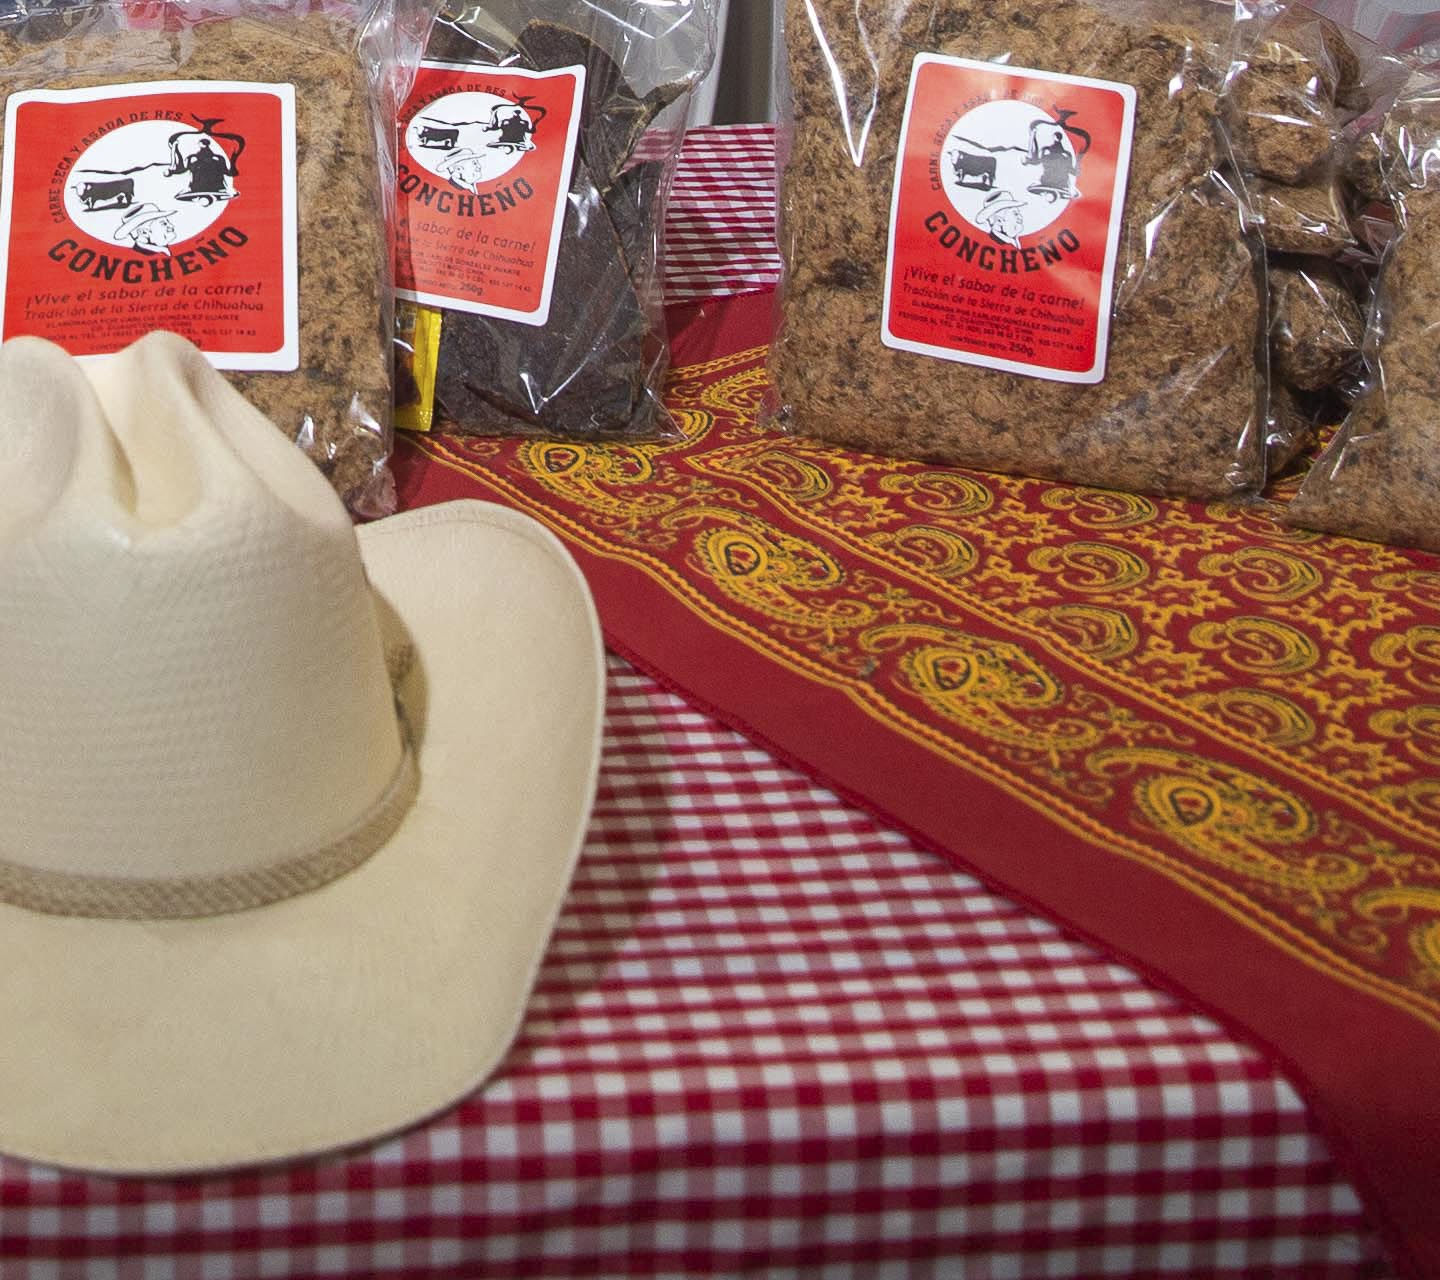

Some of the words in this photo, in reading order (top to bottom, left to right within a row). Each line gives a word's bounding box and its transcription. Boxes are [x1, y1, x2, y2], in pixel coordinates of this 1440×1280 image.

[52, 156, 73, 185] SECA
[70, 145, 80, 154] Y
[81, 117, 125, 146] ASADA
[129, 111, 148, 121] DE
[154, 110, 183, 121] RES
[456, 228, 472, 240] de
[476, 231, 488, 244] la
[925, 211, 1081, 275] CONCHEÑO
[48, 225, 248, 285] CONCHEÑO
[26, 294, 71, 309] ¡Vive
[77, 289, 92, 302] el
[99, 287, 145, 300] sabor
[155, 285, 177, 297] de
[183, 285, 197, 296] la
[204, 282, 261, 296] carne!
[91, 304, 106, 315] de
[112, 303, 125, 314] la
[128, 301, 168, 313] Sierra
[173, 300, 189, 311] de
[194, 298, 263, 312] Chihuahua
[943, 273, 954, 286] el
[959, 277, 997, 293] sabor
[1002, 285, 1017, 298] de
[1023, 289, 1035, 301] la
[1040, 292, 1085, 310] carne!
[952, 292, 964, 304] de
[1015, 304, 1027, 315] de
